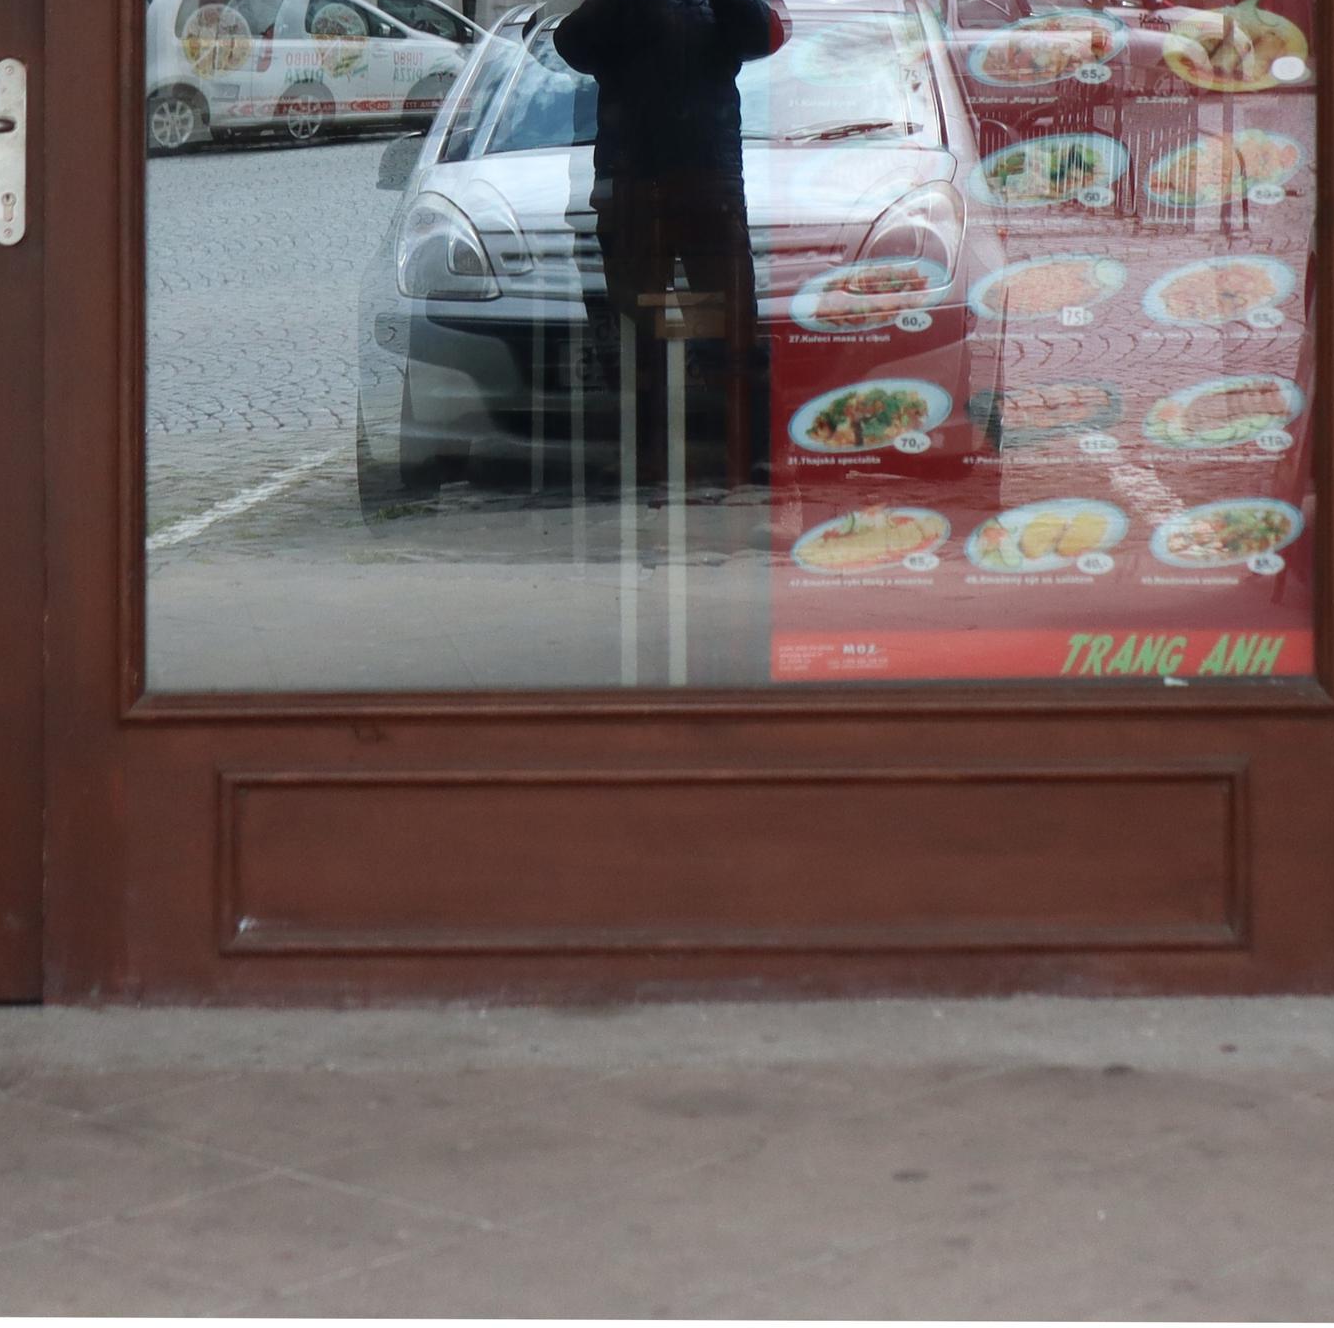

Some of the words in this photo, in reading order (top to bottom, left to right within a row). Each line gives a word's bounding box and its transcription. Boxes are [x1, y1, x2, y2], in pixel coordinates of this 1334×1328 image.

[1080, 68, 1106, 81] 65,-
[1061, 633, 1188, 676] TRANG
[1198, 633, 1285, 675] ANH
